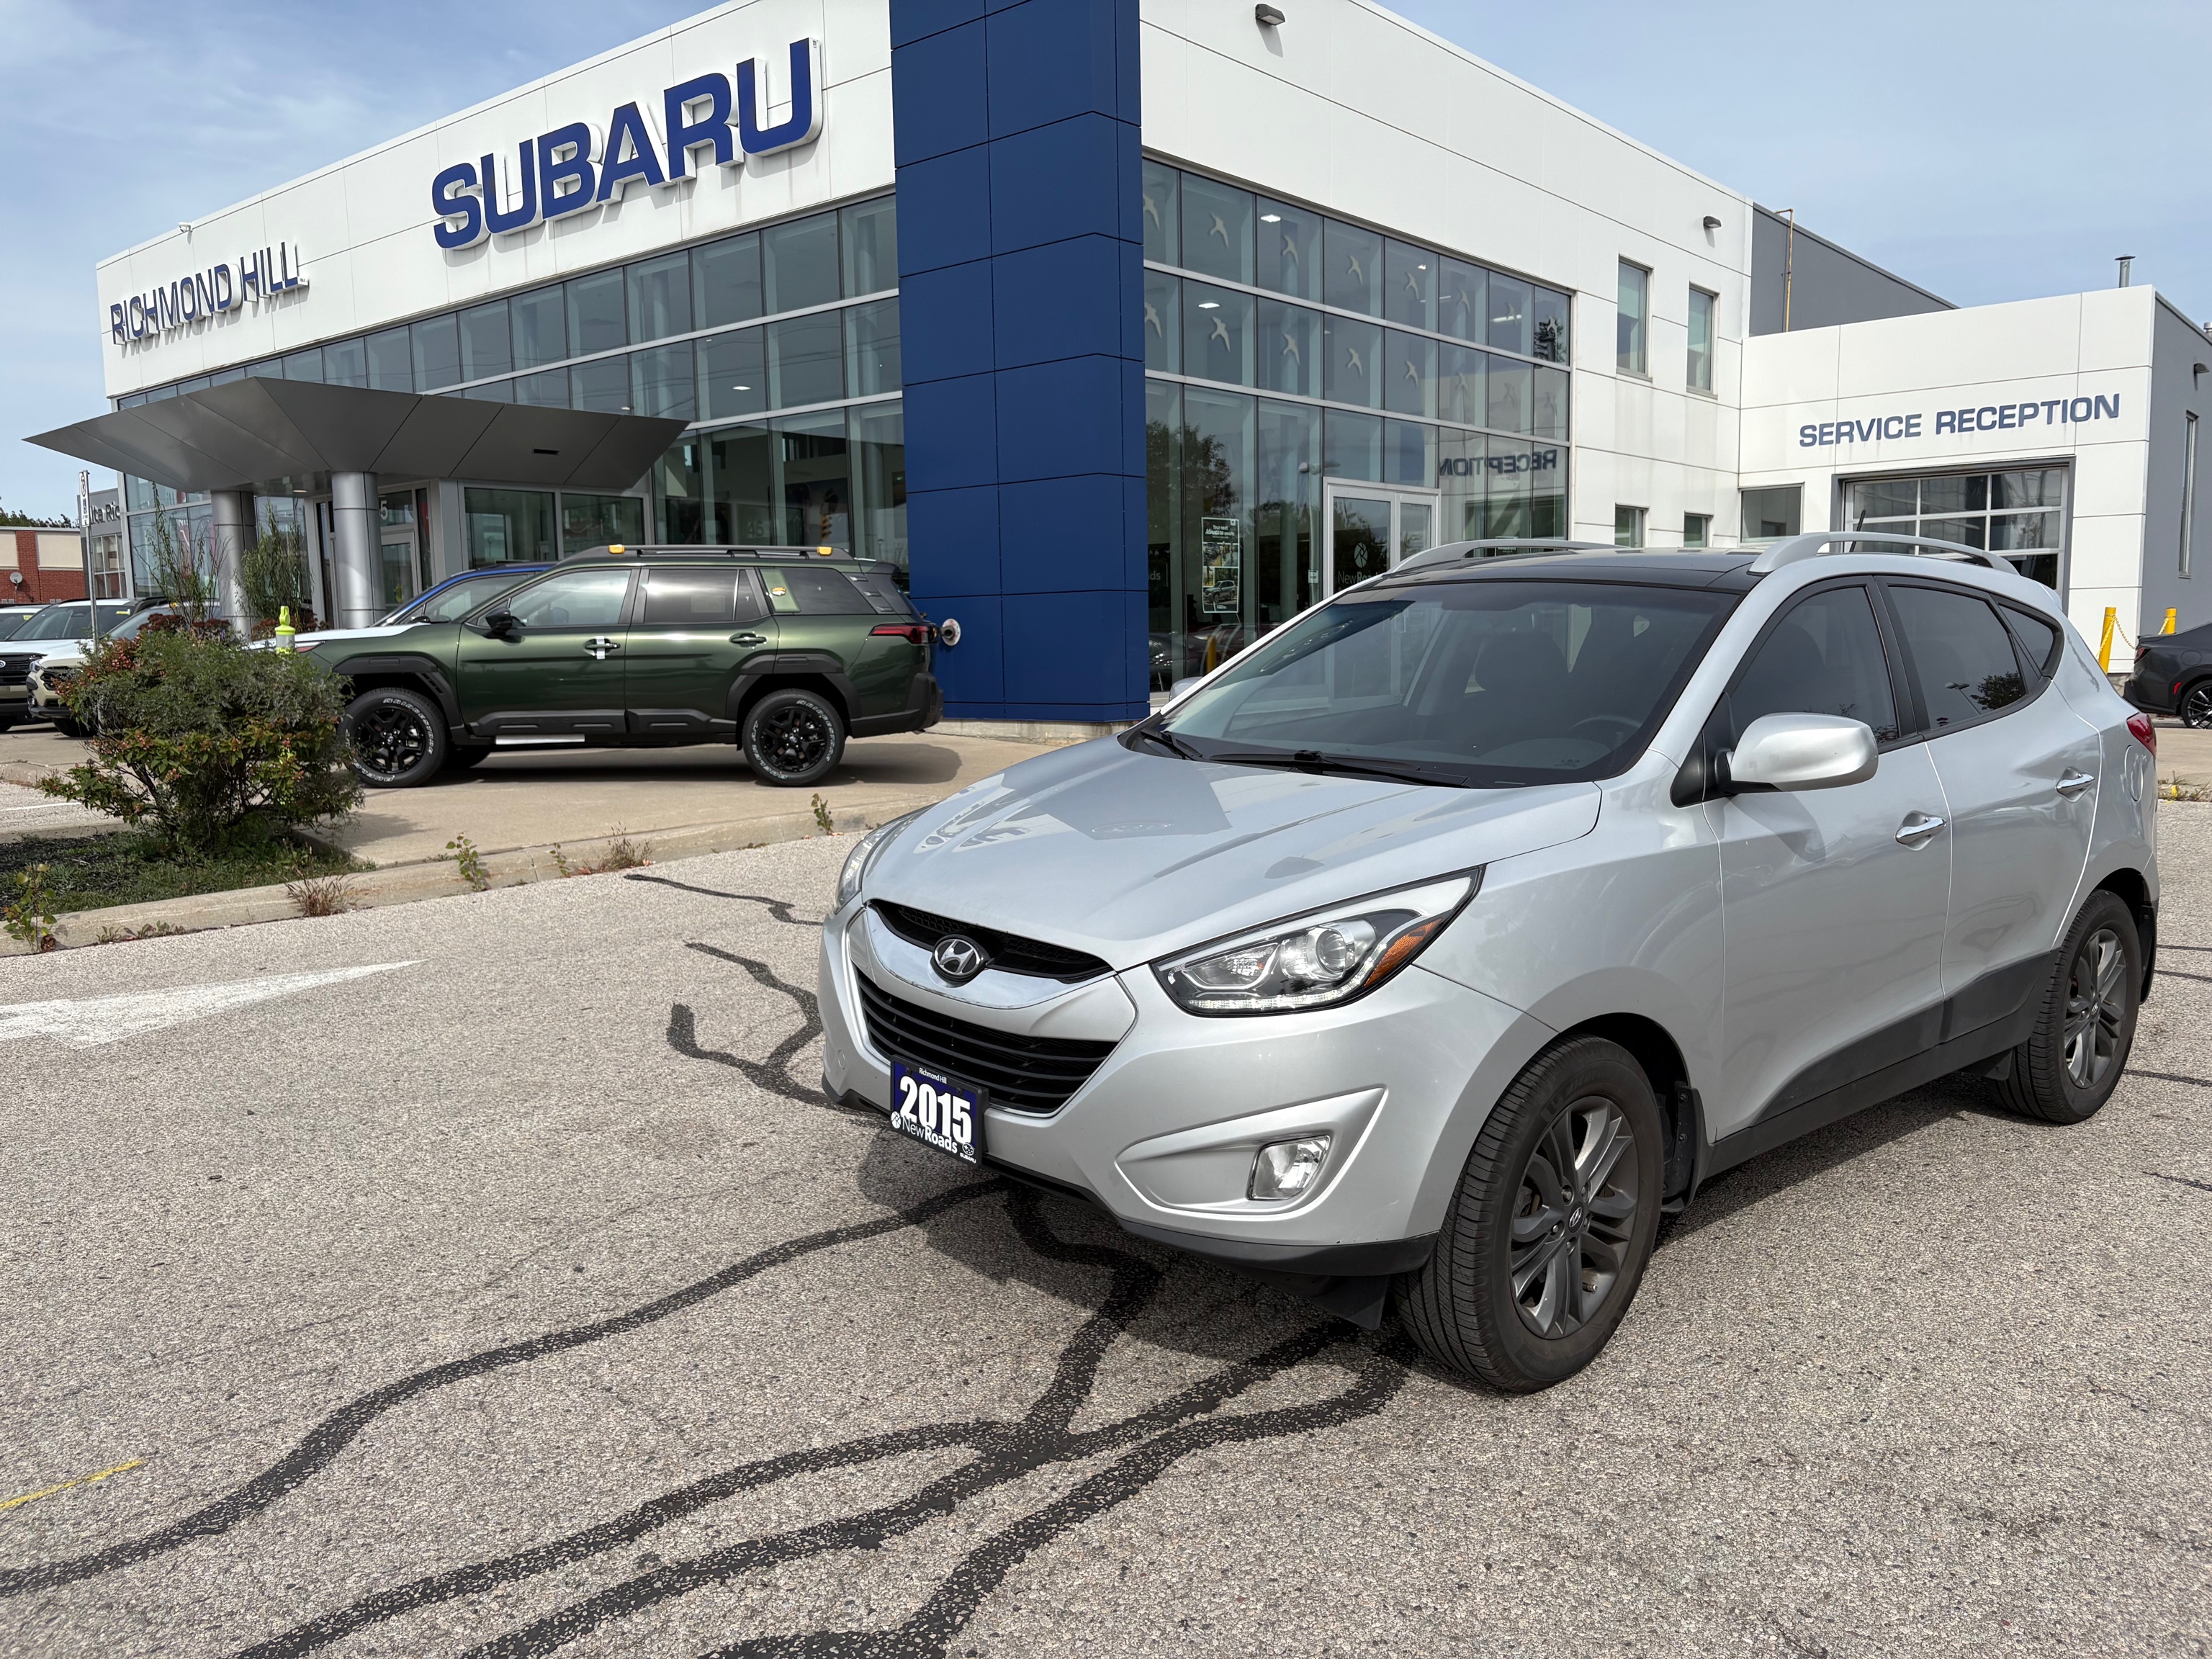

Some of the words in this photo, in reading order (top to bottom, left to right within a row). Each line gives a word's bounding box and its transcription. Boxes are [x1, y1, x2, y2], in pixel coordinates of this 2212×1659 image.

[432, 37, 813, 249] SUBARU
[110, 264, 233, 345] RICHMOND
[240, 242, 301, 302] HILL
[1799, 413, 1922, 447] SERVICE
[1935, 393, 2121, 434] RECEPTION
[90, 505, 105, 524] lta
[105, 501, 120, 521] Ric
[379, 500, 388, 521] 5
[919, 1067, 940, 1082] Richmond
[939, 1074, 948, 1084] Hill
[900, 1075, 972, 1145] 2015
[902, 1115, 958, 1154] NewRoads
[959, 1152, 977, 1164] SUBARU
